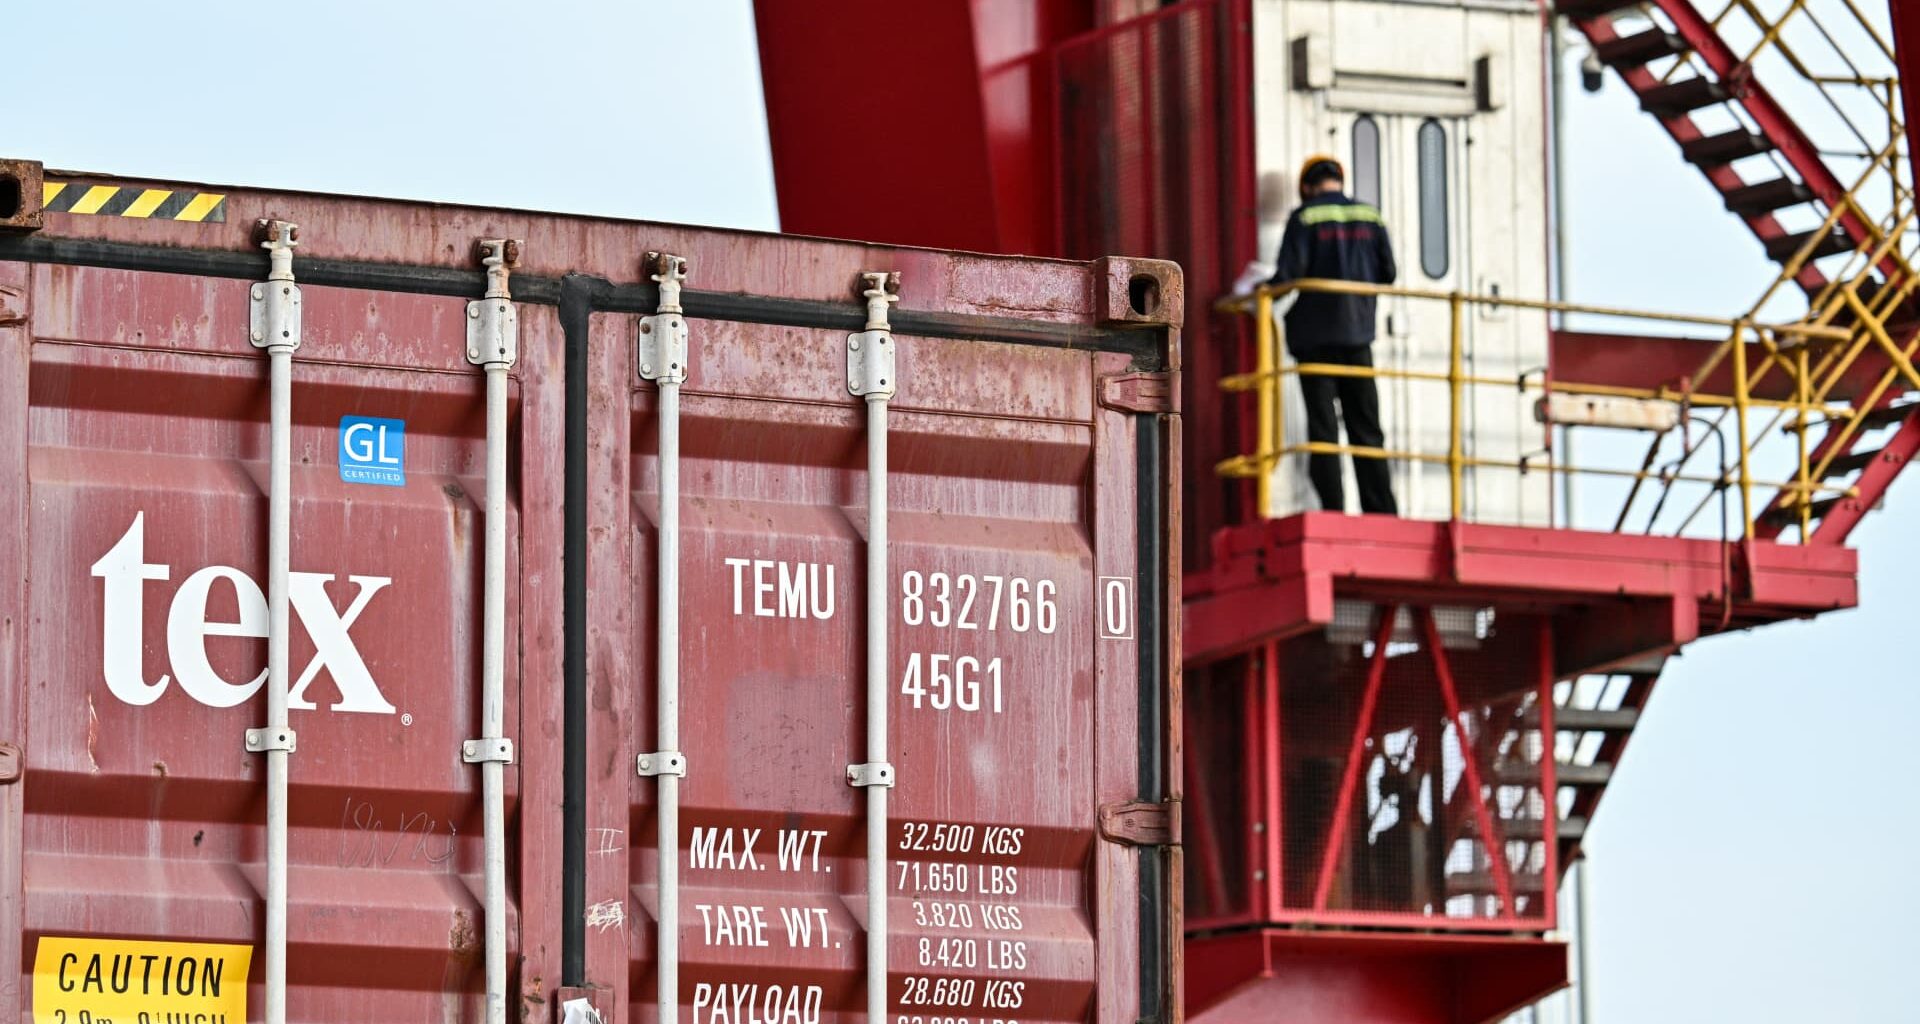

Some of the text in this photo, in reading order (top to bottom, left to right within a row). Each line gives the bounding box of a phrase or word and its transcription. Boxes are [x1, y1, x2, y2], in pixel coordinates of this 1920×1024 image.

[343, 422, 400, 464] GL
[343, 470, 401, 482] CERTIFIED
[90, 510, 396, 714] tex
[725, 557, 1127, 635] TEMU 832766 0
[901, 652, 1003, 713] 45G1
[689, 826, 831, 873] MAX. WT.
[900, 822, 1024, 855] 32,500 KGS
[896, 861, 1018, 895] 71,650 LBS
[695, 904, 841, 949] TARE WT.
[912, 901, 1023, 930] 3,820 KGS
[919, 937, 1027, 970] 8,420 LBS
[58, 952, 224, 997] CAUTION
[900, 977, 1025, 1008] 28,680 KGS
[693, 983, 823, 1024] PAYLOAD
